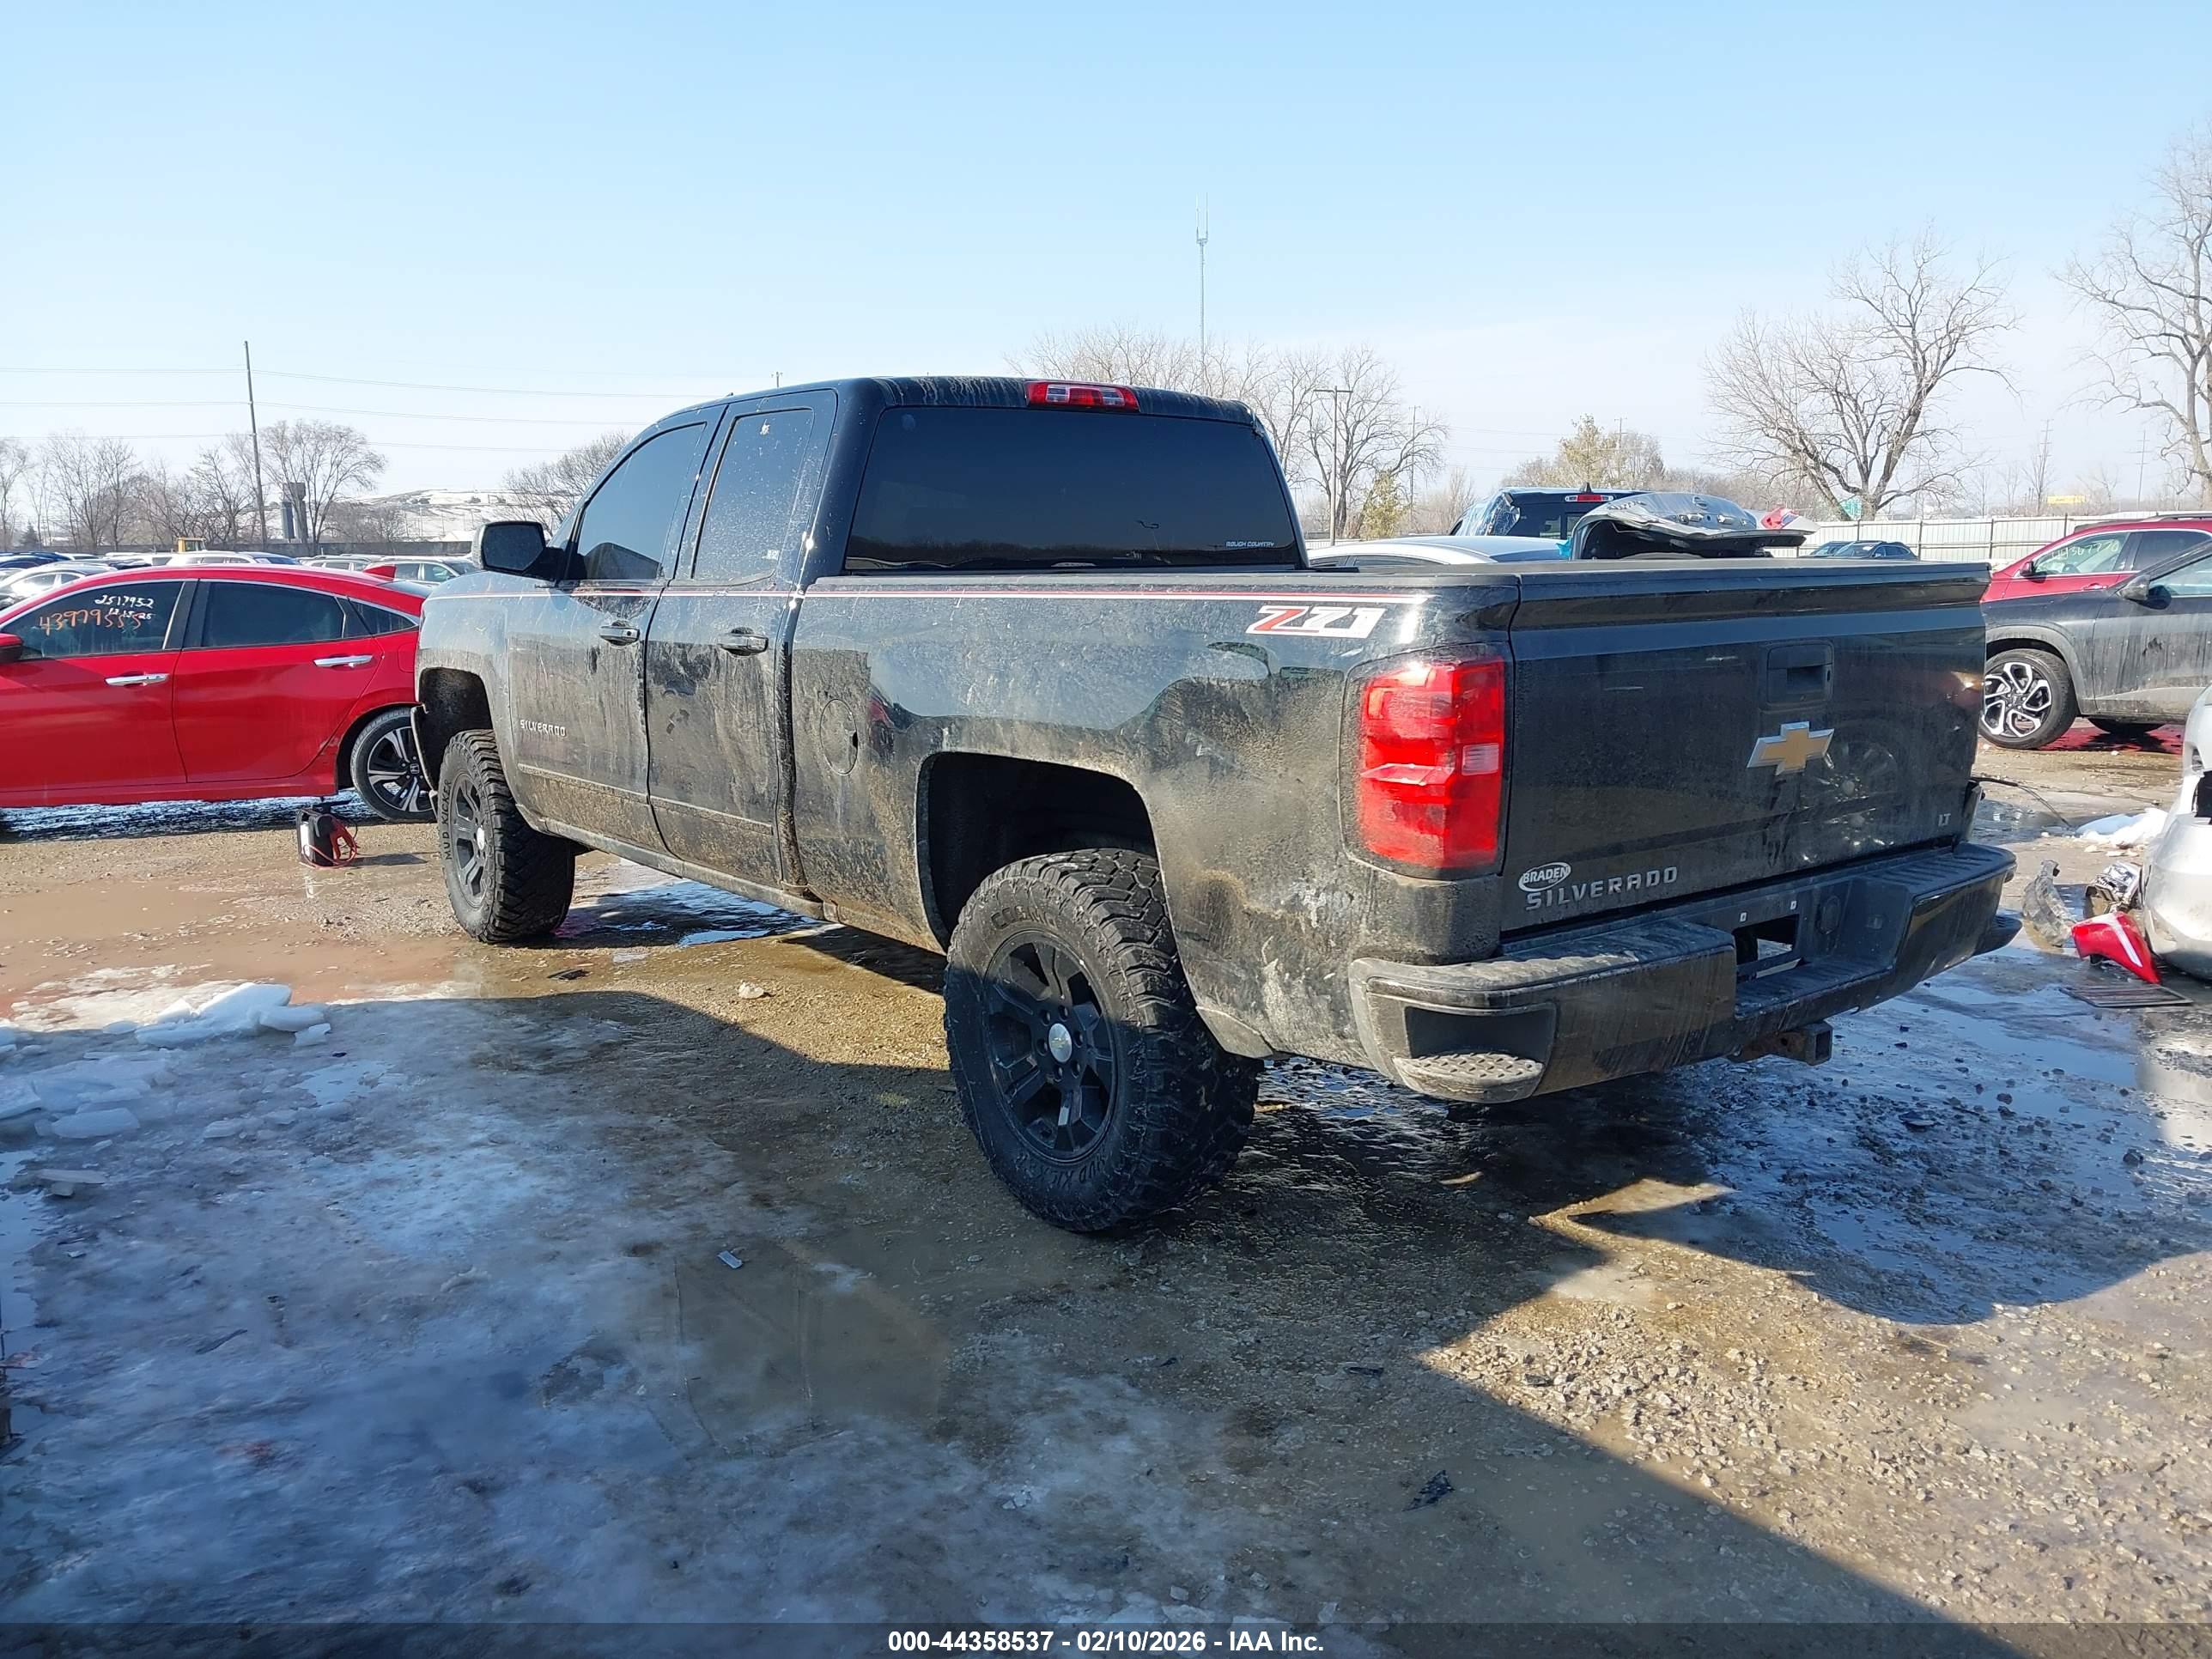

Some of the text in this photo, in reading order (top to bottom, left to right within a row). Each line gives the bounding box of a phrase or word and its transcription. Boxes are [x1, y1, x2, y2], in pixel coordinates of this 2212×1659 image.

[1246, 605, 1389, 639] Z71
[520, 719, 567, 737] SILVERADO
[441, 779, 453, 860] MUD KICKER
[1938, 812, 1952, 827] LT
[1522, 866, 1570, 884] BRADEN
[1525, 866, 1678, 911] SILVERADO
